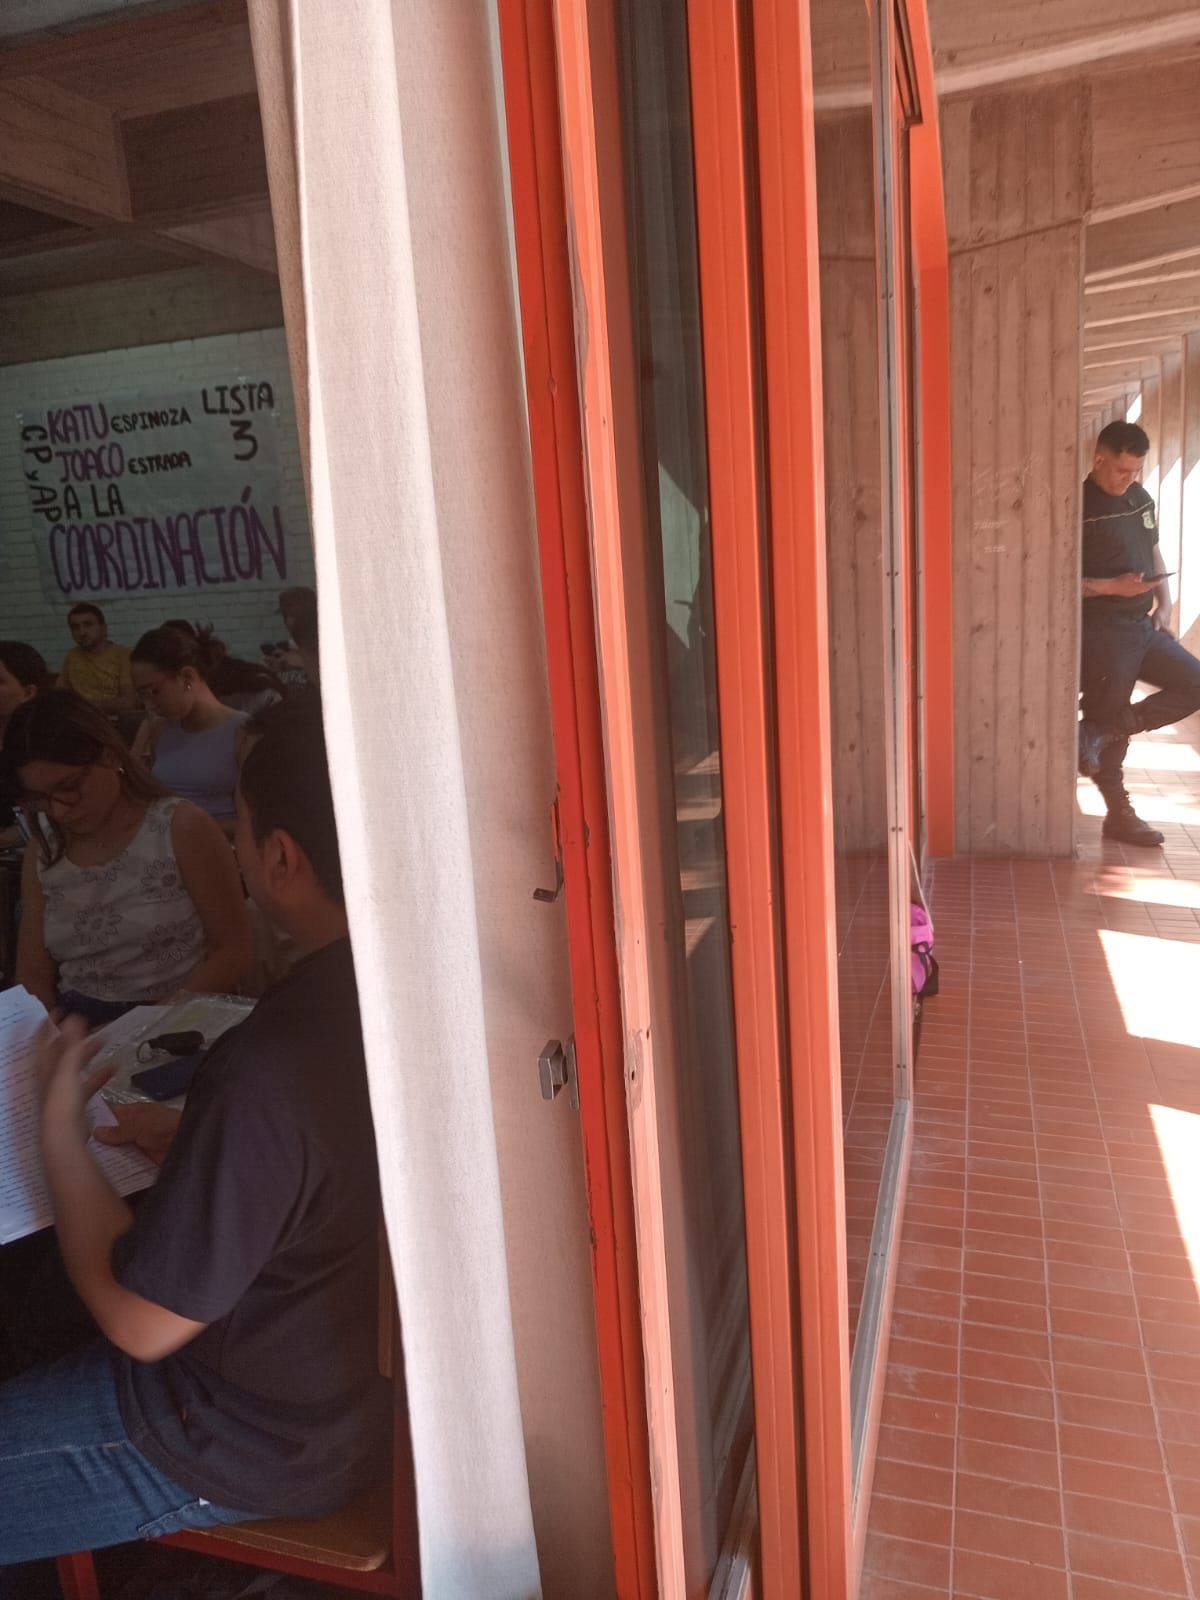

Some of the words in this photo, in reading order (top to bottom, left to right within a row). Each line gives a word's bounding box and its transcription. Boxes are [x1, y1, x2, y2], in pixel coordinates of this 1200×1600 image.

[201, 382, 274, 415] LISTA
[47, 403, 109, 444] KATU
[111, 408, 191, 433] ESPINOZA
[230, 420, 258, 461] 3
[56, 443, 124, 483] JOACO
[128, 451, 192, 474] ESTRADA
[64, 485, 81, 519] A
[91, 483, 125, 517] LA
[50, 486, 286, 594] COORDINACIÓN
